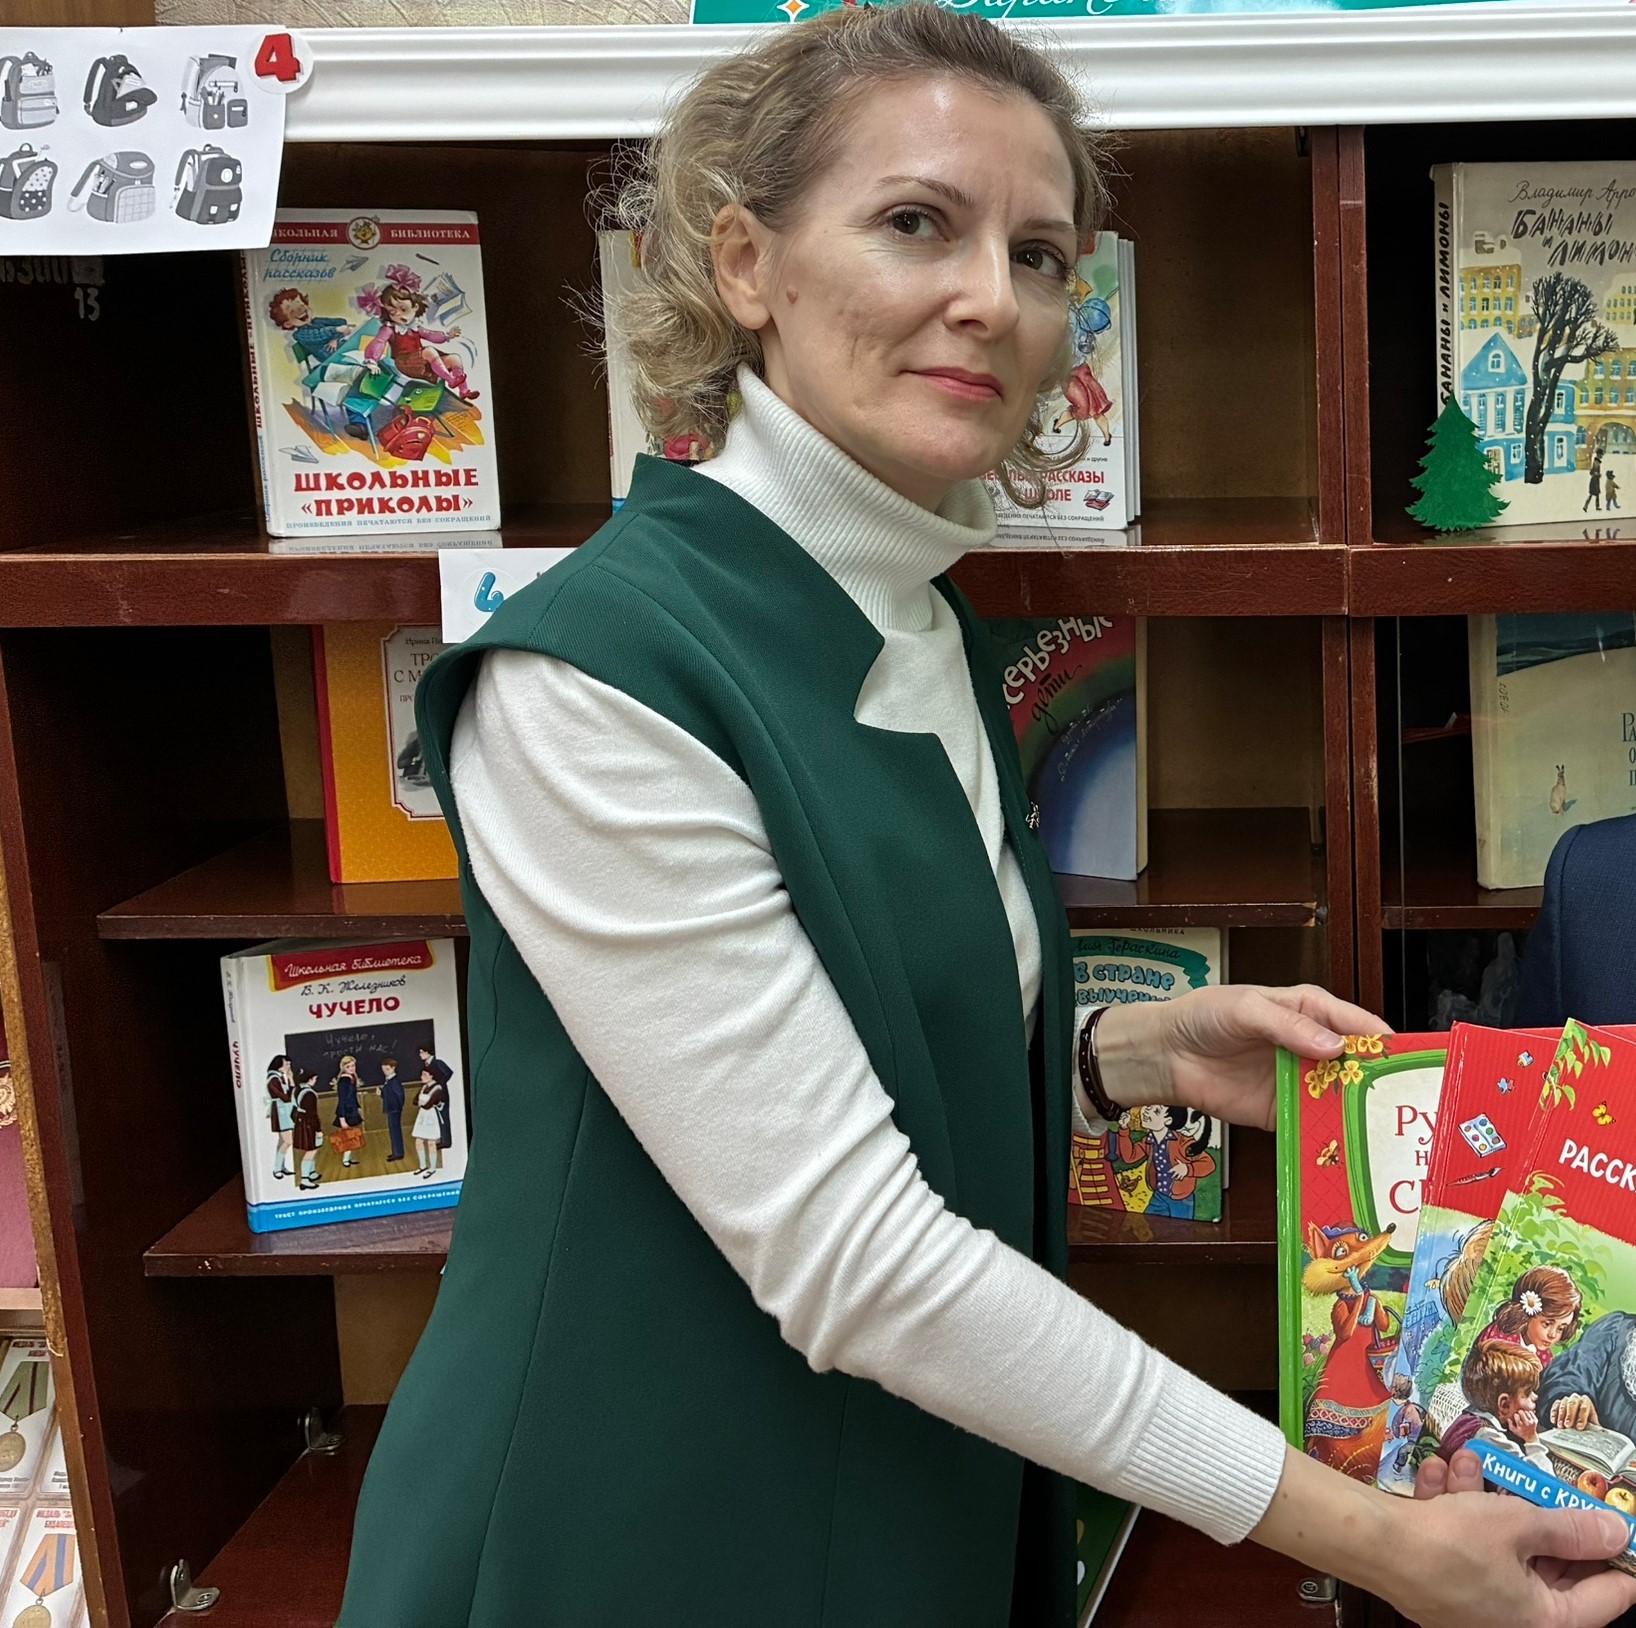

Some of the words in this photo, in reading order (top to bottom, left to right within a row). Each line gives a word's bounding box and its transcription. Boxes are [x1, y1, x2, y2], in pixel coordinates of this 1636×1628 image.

[254, 33, 301, 84] 4
[1507, 179, 1593, 209] Владимир
[1596, 179, 1636, 210] Арро
[390, 228, 471, 239] БИБЛИОТЕКА
[1510, 208, 1613, 240] БАНАНЫ
[269, 248, 329, 265] Сборник
[1438, 202, 1451, 299] ЛИМОНЫ
[1547, 239, 1636, 267] ЛИМОН
[262, 267, 337, 283] рассказов
[293, 467, 479, 493] ШКОЛЬНЫЕ
[301, 493, 474, 517] «ПРИКОЛЫ»
[1025, 488, 1072, 501] ШОЛЕ
[356, 517, 413, 527] ПЕЧАТАЮТСЯ
[416, 517, 432, 525] БЕЗ
[434, 514, 492, 524] СОКРАЩЕНИЙ
[285, 962, 348, 978] Школьная
[351, 954, 423, 970] библиотека
[301, 985, 314, 997] В.
[339, 974, 407, 994] Железников
[309, 996, 401, 1019] ЧУЧЕЛО
[232, 1040, 243, 1089] ЧУЧЕЛО
[1558, 1138, 1636, 1193] РАССК
[1482, 1452, 1537, 1493] Книги
[1554, 1487, 1603, 1510] КРУ
